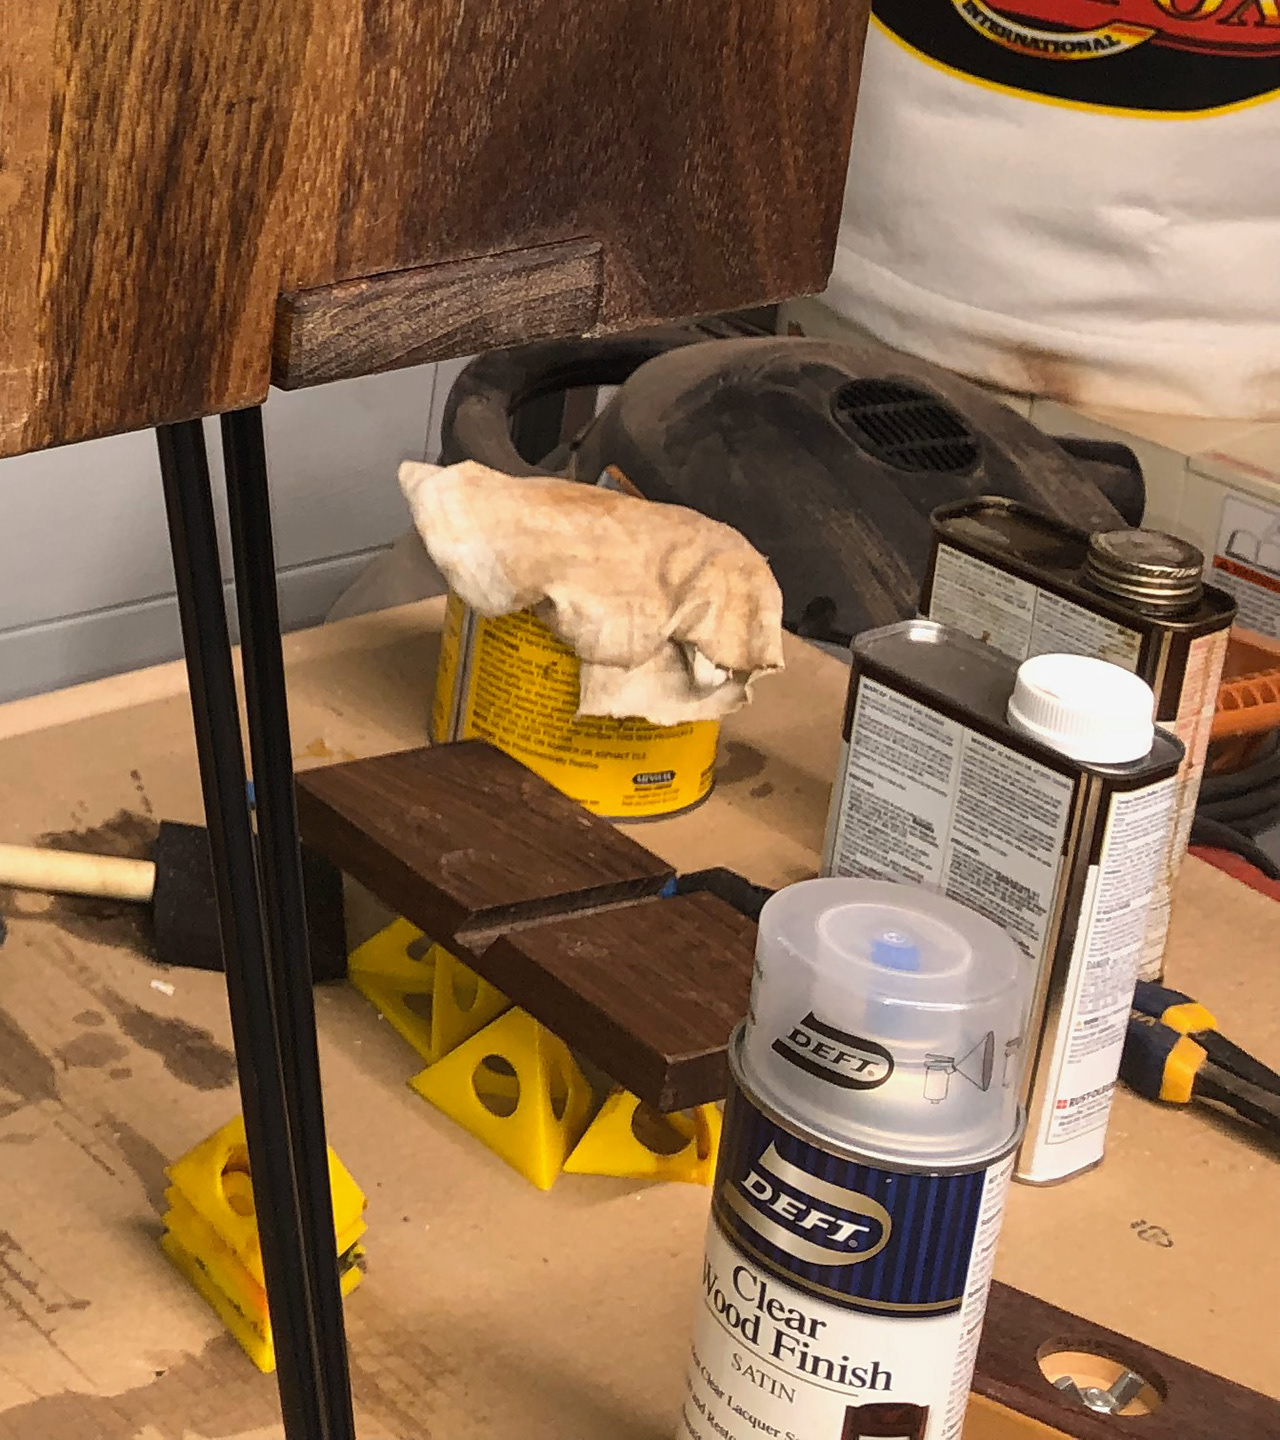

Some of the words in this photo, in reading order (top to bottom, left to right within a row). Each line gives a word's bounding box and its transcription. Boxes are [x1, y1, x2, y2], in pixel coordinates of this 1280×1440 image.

[786, 1027, 880, 1074] DEFT
[740, 1167, 870, 1243] DEFT
[702, 1253, 760, 1346] Wood
[769, 1327, 893, 1392] Finish
[732, 1265, 827, 1340] Clear
[730, 1352, 797, 1405] SATIN
[727, 1395, 782, 1439] Lacquer
